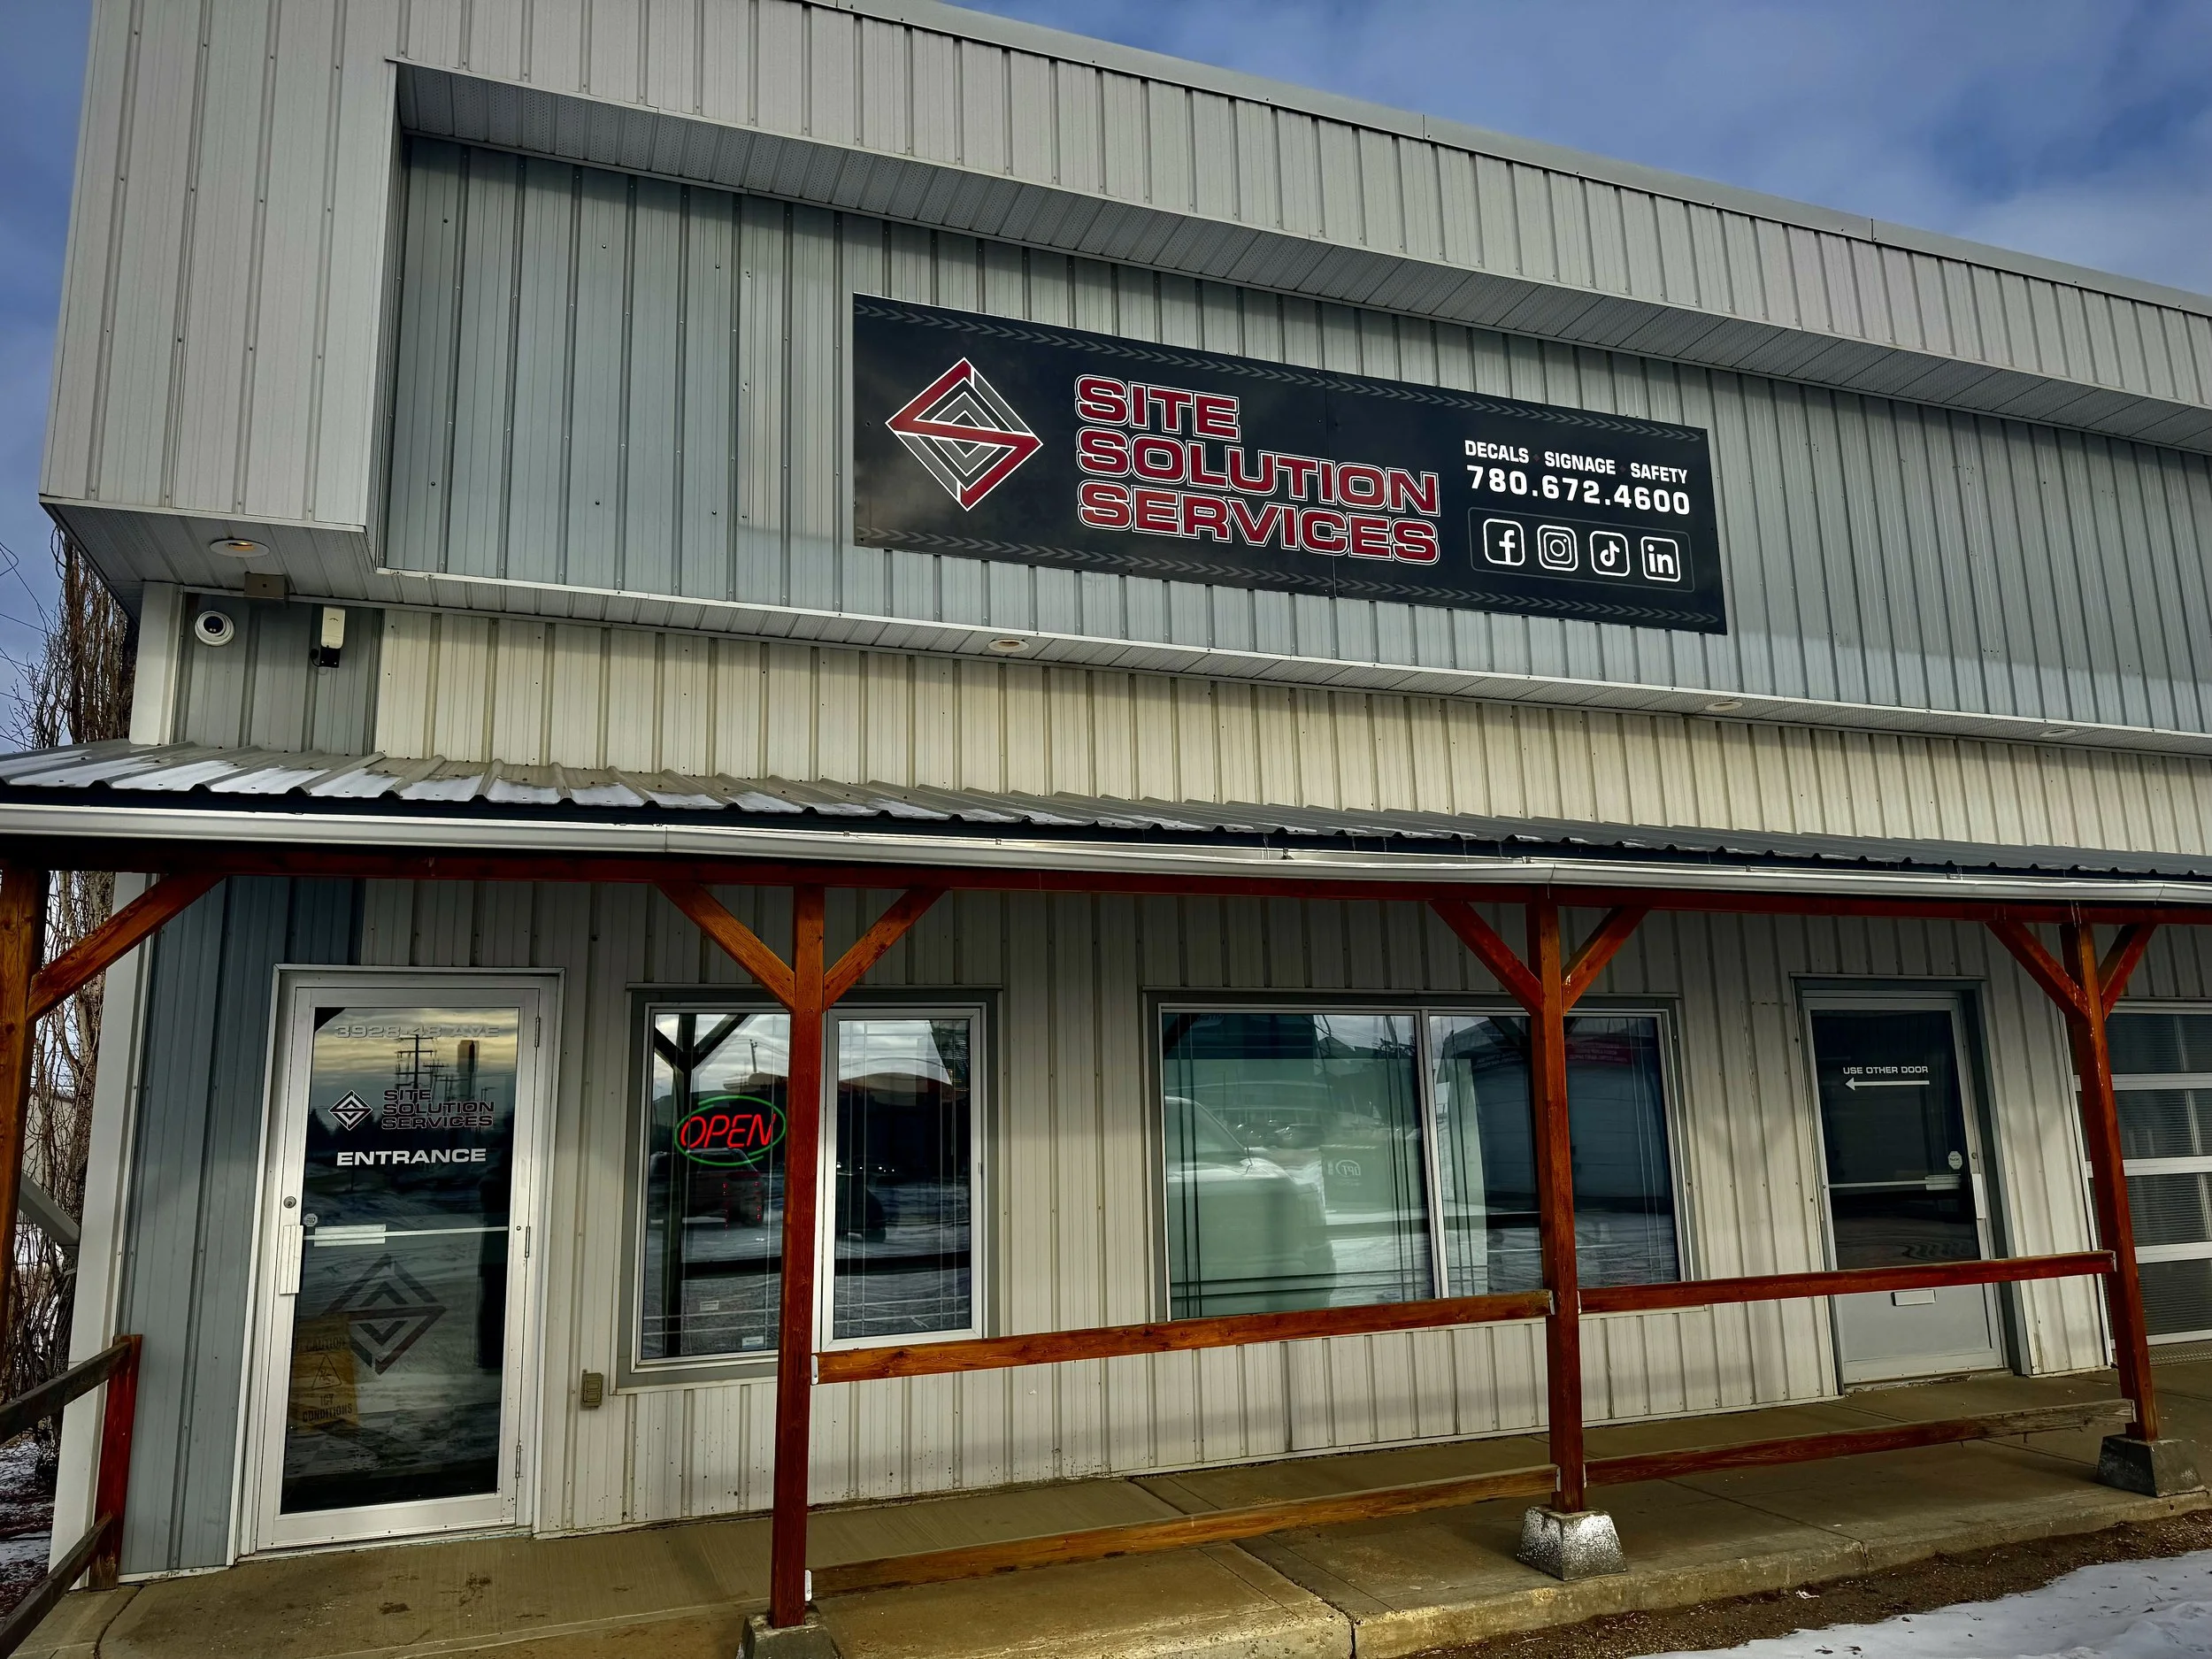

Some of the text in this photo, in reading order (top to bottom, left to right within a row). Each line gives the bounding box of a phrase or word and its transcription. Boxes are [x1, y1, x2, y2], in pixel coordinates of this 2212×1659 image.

[1074, 373, 1240, 442] SITE
[1075, 426, 1441, 517] SOLUTION
[1464, 440, 1688, 485] DECALS SIGNAGE SAFETY
[1465, 465, 1691, 516] 780.672.4600
[1076, 479, 1441, 565] SERVICES
[449, 1025, 501, 1038] AVE
[382, 1101, 495, 1116] SOLUTION
[383, 1089, 432, 1102] SITE
[381, 1115, 493, 1129] SERVICES
[680, 1113, 776, 1148] OPEN
[336, 1148, 487, 1166] ENTRANCE
[302, 1402, 353, 1423] CONDITIONS
